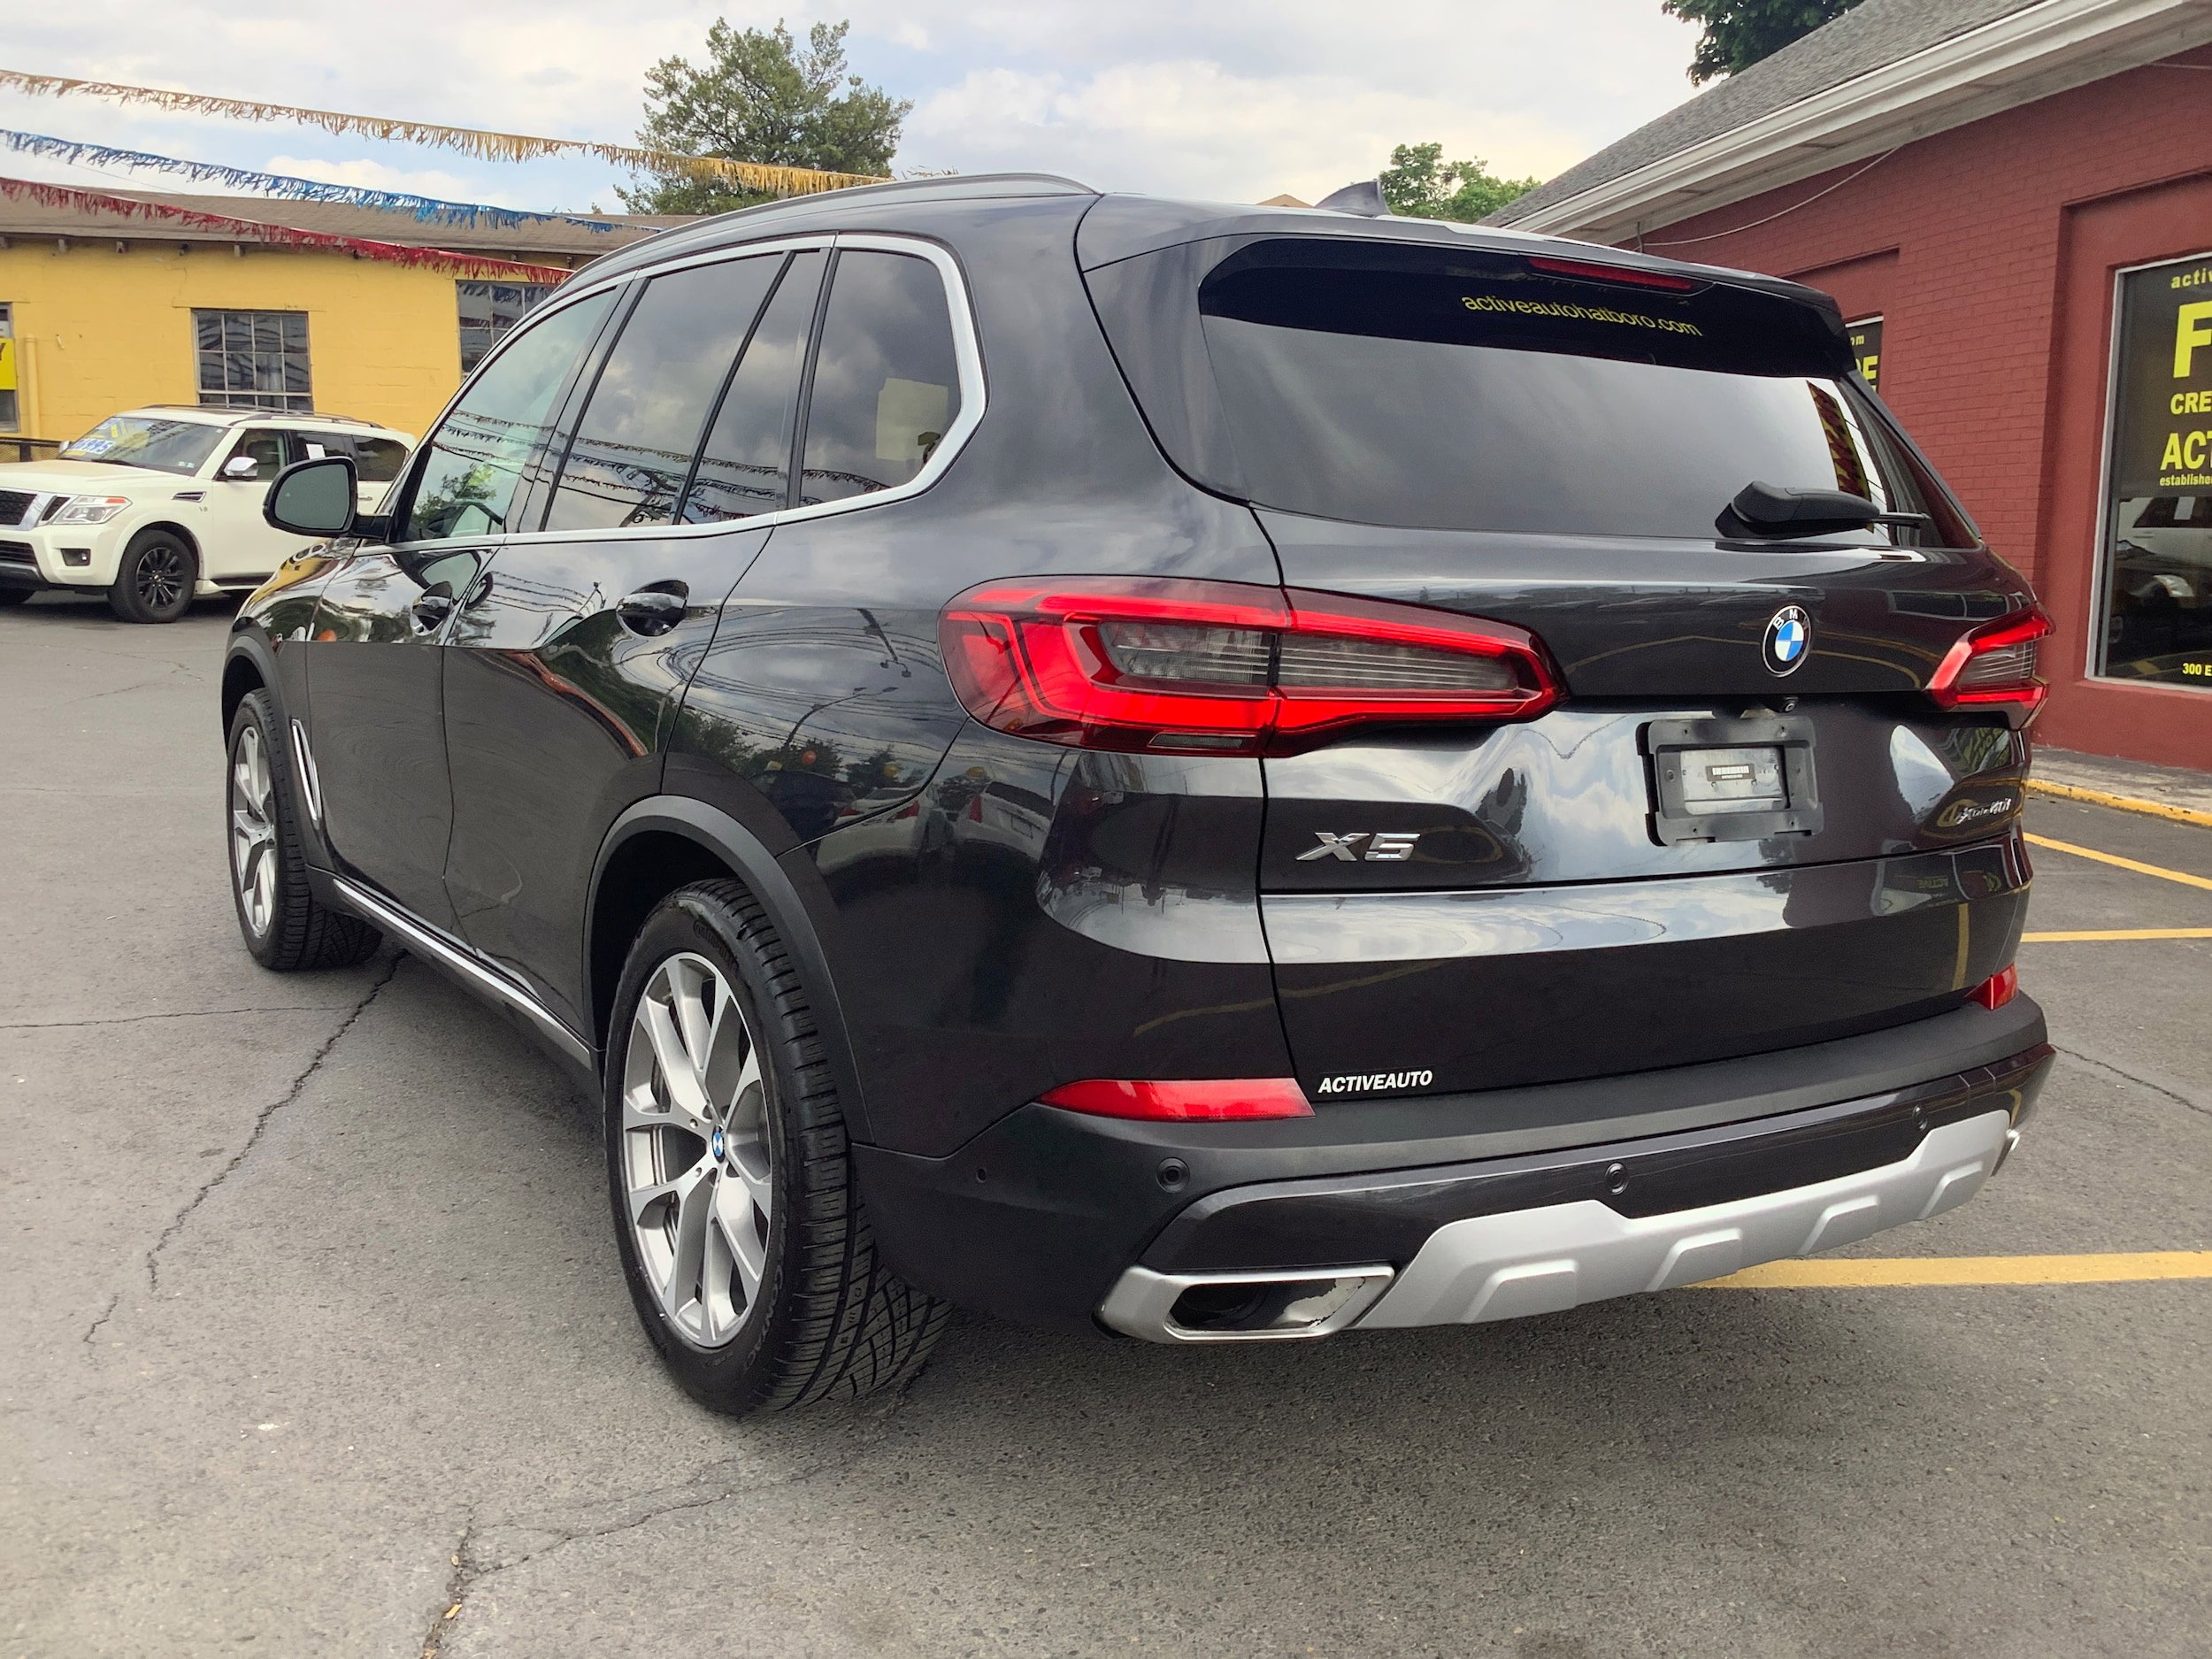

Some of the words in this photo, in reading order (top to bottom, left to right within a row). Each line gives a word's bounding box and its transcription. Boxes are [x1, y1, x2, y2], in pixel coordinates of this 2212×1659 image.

[1461, 295, 1704, 337] activeautohatboro.com
[2173, 301, 2212, 378] F
[2170, 391, 2212, 415] CRE
[2182, 663, 2202, 675] 300
[1295, 832, 1421, 862] X5
[1317, 1070, 1433, 1094] ACTIVEAUTO
